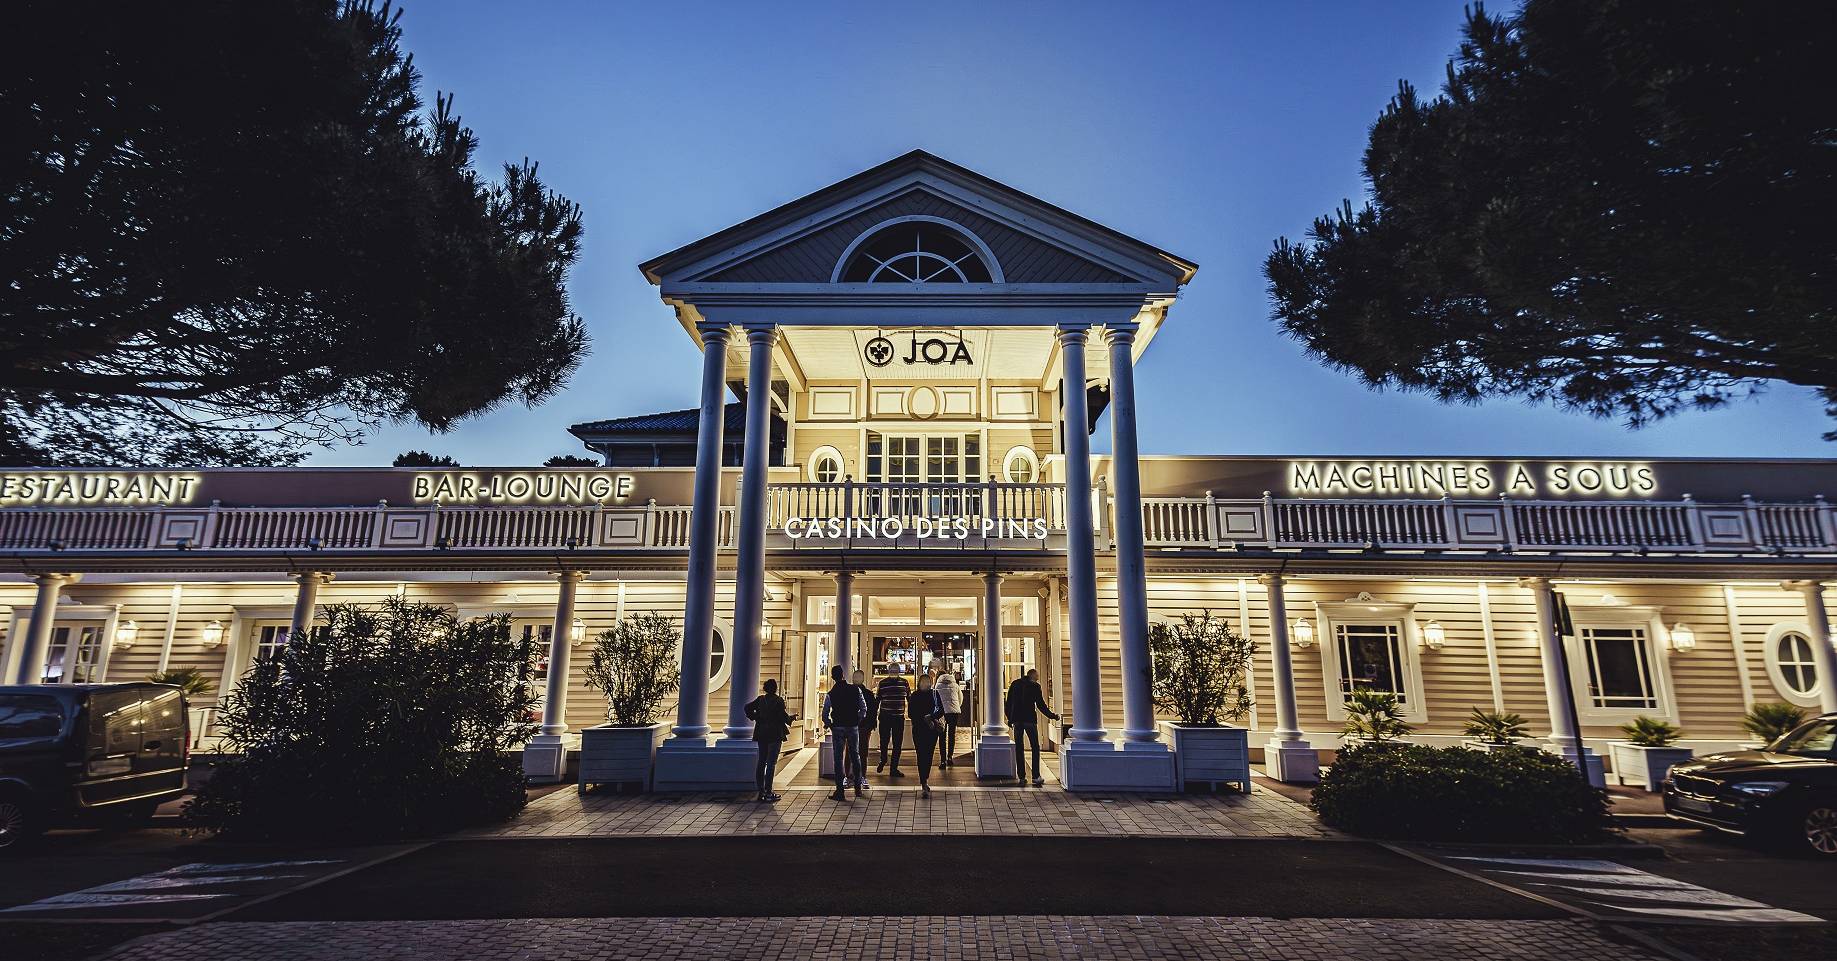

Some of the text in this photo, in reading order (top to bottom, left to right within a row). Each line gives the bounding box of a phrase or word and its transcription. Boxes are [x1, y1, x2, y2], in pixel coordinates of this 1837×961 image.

[903, 339, 973, 365] JOA
[0, 476, 195, 500] ESTAURANT
[414, 476, 632, 499] BAR-LOUNGE
[1294, 465, 1654, 490] MACHINES A SOUS
[784, 517, 1048, 540] CASINO DES PINS
